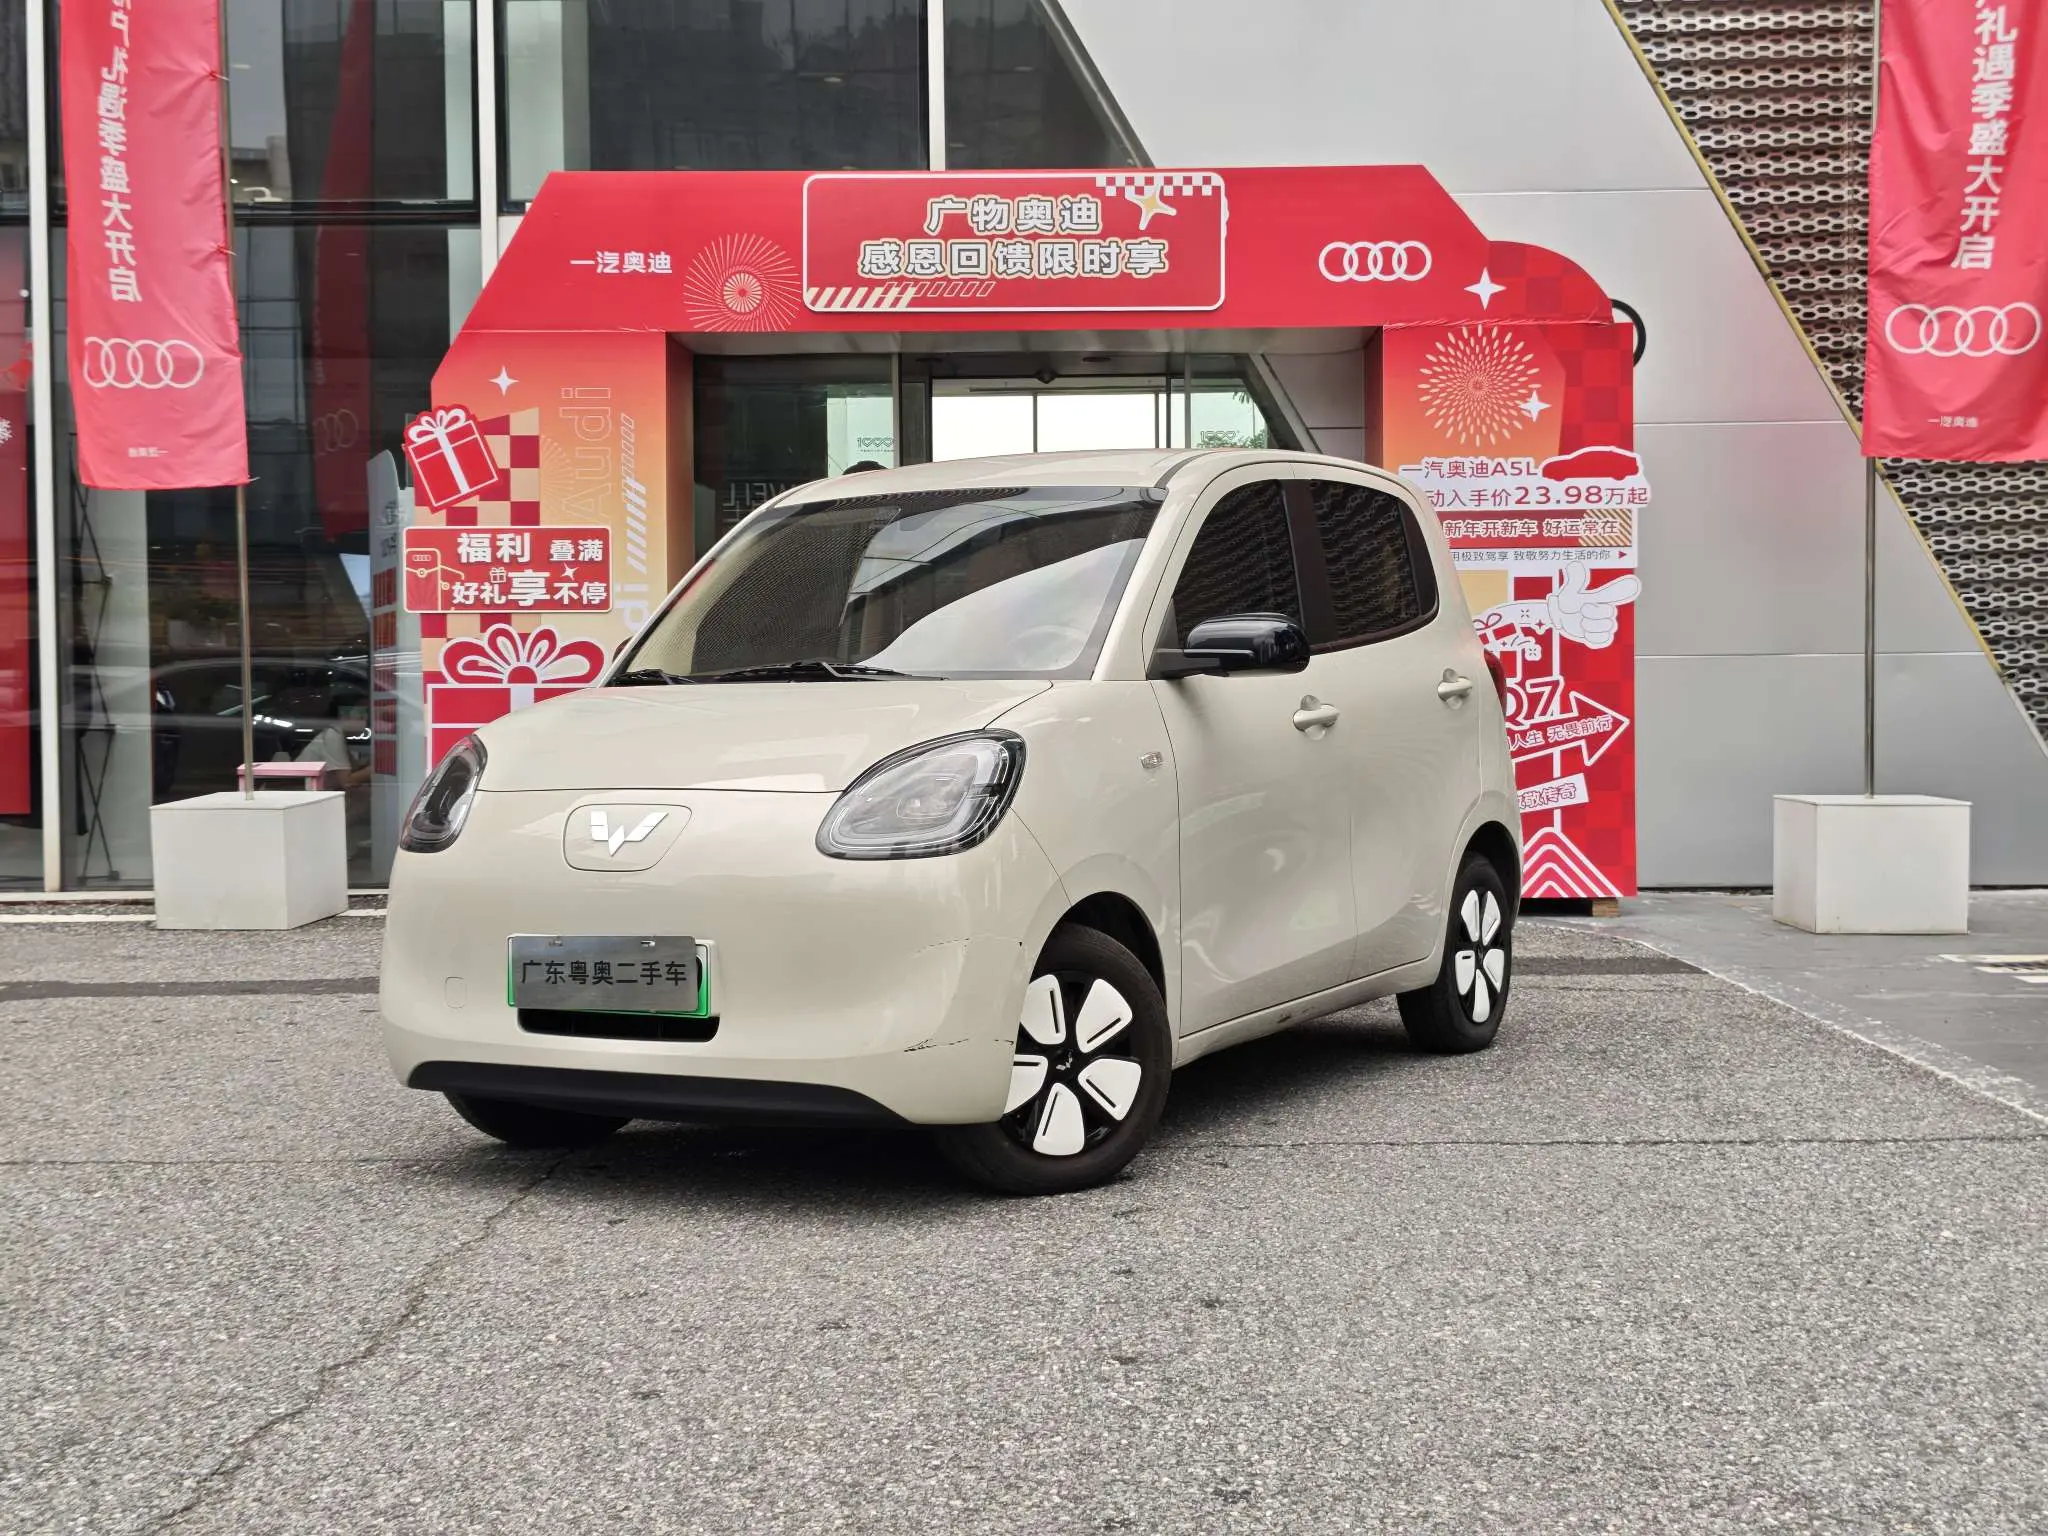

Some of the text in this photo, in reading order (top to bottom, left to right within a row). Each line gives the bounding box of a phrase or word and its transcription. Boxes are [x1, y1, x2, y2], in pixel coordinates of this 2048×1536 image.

[1949, 0, 2019, 270] 礼遇季盛大开启
[926, 197, 1100, 234] 广物奥迪
[569, 250, 673, 274] 一汽奥迪
[860, 241, 1167, 277] 感恩回馈限时享
[559, 386, 613, 524] Audi
[1401, 460, 1538, 479] 一汽奥迪A5L
[1443, 519, 1620, 538] 新年开新车 好运常在
[456, 531, 604, 564] 福利 叠满
[1513, 549, 1611, 561] 致敬努力生活的你
[451, 569, 608, 607] 好礼享不停
[1507, 715, 1613, 751] 人生 无畏前行
[520, 959, 688, 987] 广东粤奥二手车
